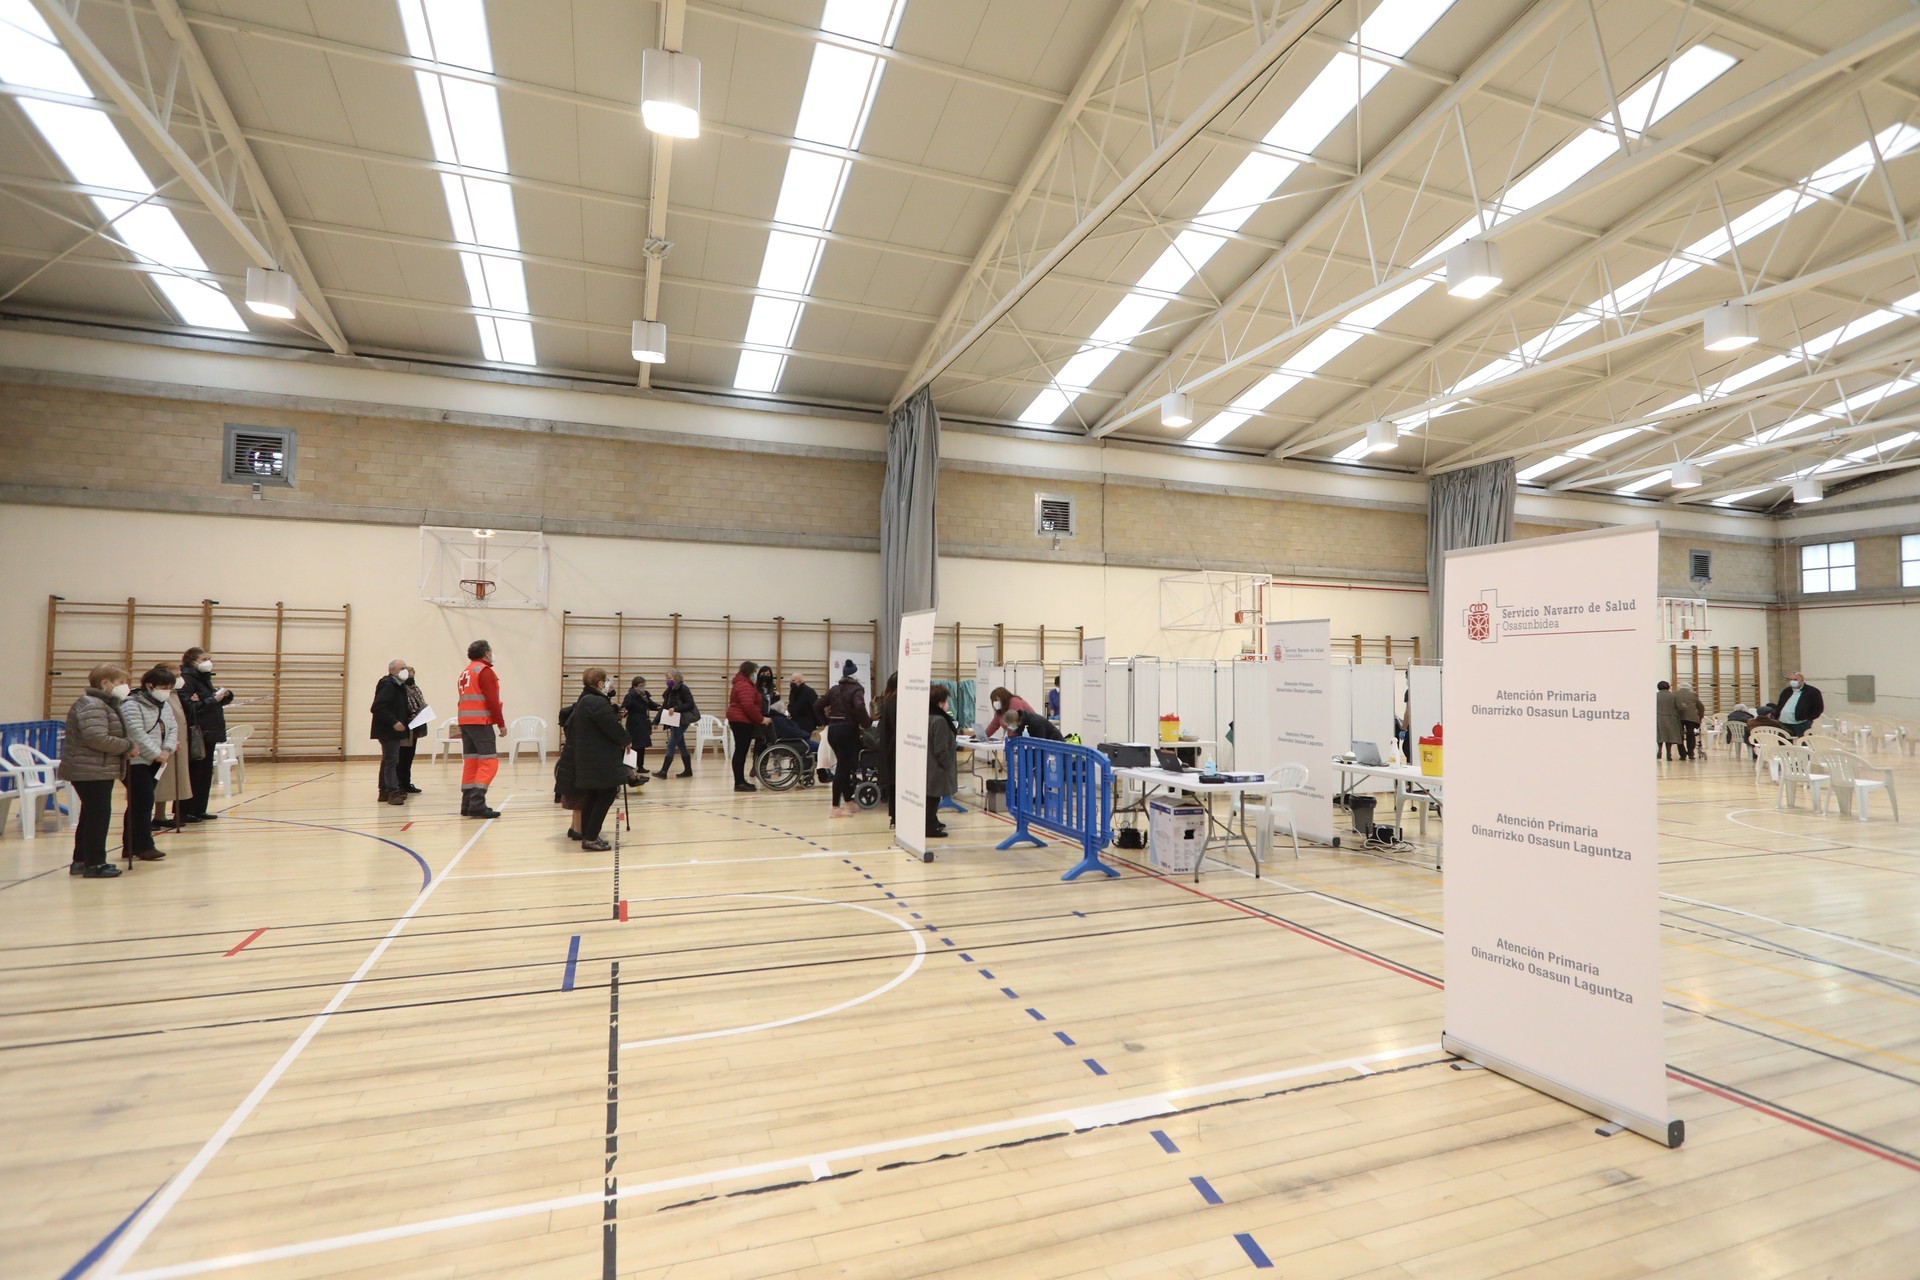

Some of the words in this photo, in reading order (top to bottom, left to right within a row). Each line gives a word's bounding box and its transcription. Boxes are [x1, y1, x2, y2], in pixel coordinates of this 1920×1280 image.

[1502, 608, 1540, 619] Servicio
[1543, 605, 1585, 616] Navarro
[1588, 602, 1601, 613] de
[1605, 599, 1637, 612] Salud
[1502, 620, 1560, 631] Osasunbidea
[1496, 689, 1544, 701] Atención
[1546, 690, 1597, 702] Primaria
[1471, 704, 1524, 717] Oinarrizko
[1526, 706, 1569, 718] Osasun
[1572, 707, 1630, 722] Laguntza
[1496, 812, 1545, 830] Atención
[1548, 820, 1599, 838] Primaria
[1471, 824, 1525, 843] Oinarrizko
[1528, 834, 1570, 851] Osasun
[1573, 841, 1632, 862] Laguntza
[1496, 938, 1545, 961] Atención
[1548, 952, 1600, 977] Primaria
[1471, 946, 1525, 972] Oinarrizko
[1528, 963, 1571, 985] Osasun
[1574, 976, 1634, 1005] Laguntza
